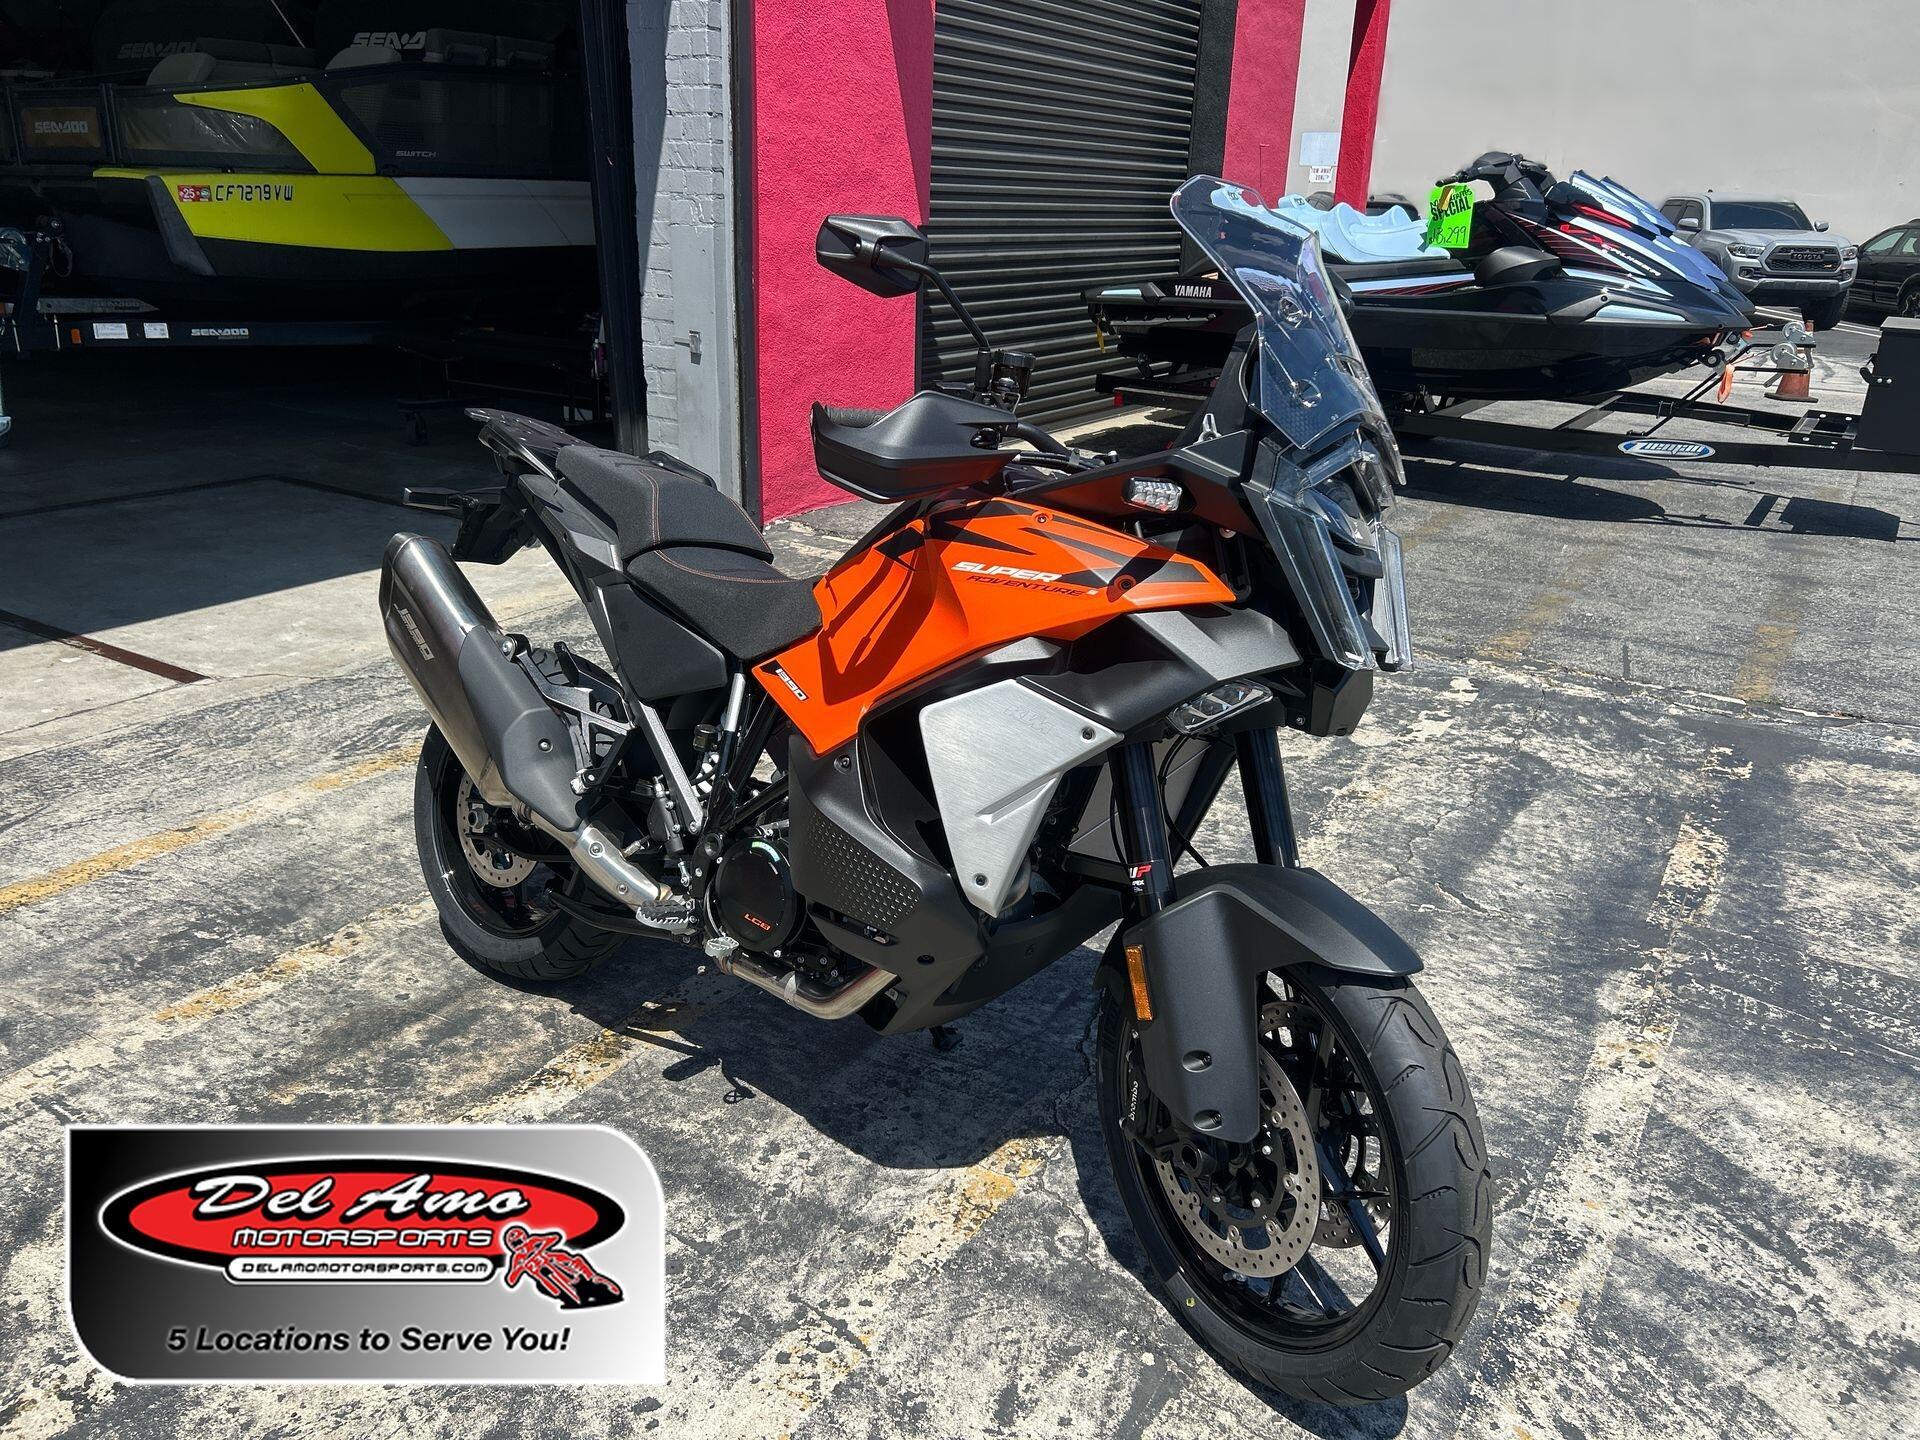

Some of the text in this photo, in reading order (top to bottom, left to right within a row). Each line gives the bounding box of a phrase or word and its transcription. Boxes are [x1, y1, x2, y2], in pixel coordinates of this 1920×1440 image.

[395, 150, 437, 158] SWITCH
[184, 188, 195, 198] 25
[1431, 197, 1471, 221] SPECIAL
[1792, 252, 1822, 260] TOYOTA
[1175, 284, 1212, 298] YAMAHA
[951, 561, 1063, 582] SUPER
[967, 575, 1085, 597] ADVENTURE
[775, 668, 808, 701] 1390
